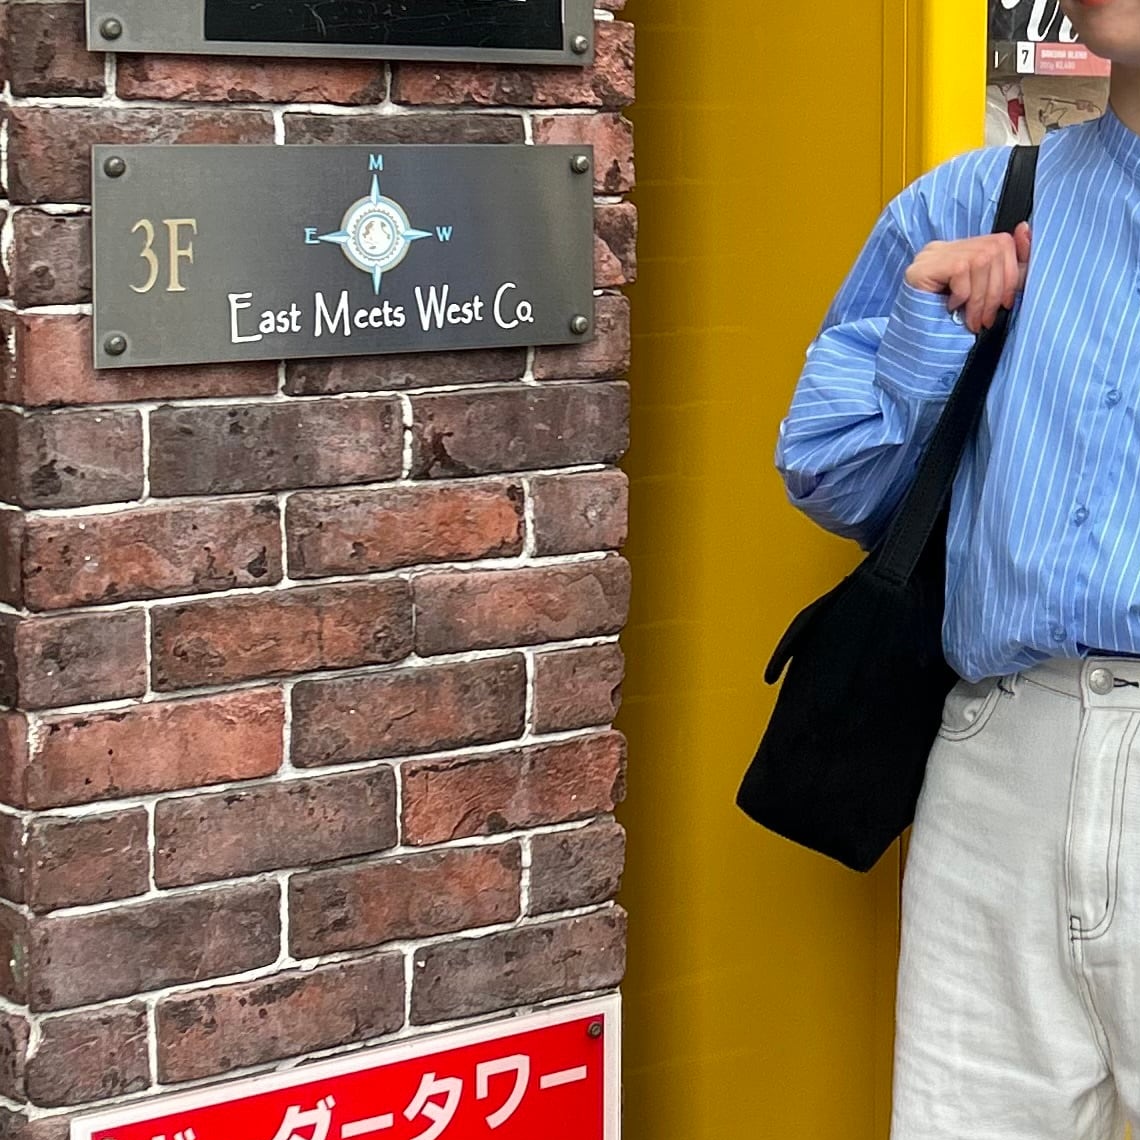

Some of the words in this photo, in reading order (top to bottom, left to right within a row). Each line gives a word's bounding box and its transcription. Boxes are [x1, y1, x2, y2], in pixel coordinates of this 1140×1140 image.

[1022, 50, 1029, 64] 7
[369, 154, 383, 171] M
[304, 227, 320, 244] E
[436, 226, 453, 241] W
[129, 218, 198, 293] 3F
[228, 292, 302, 343] East
[314, 290, 406, 337] Meets
[415, 284, 484, 332] West
